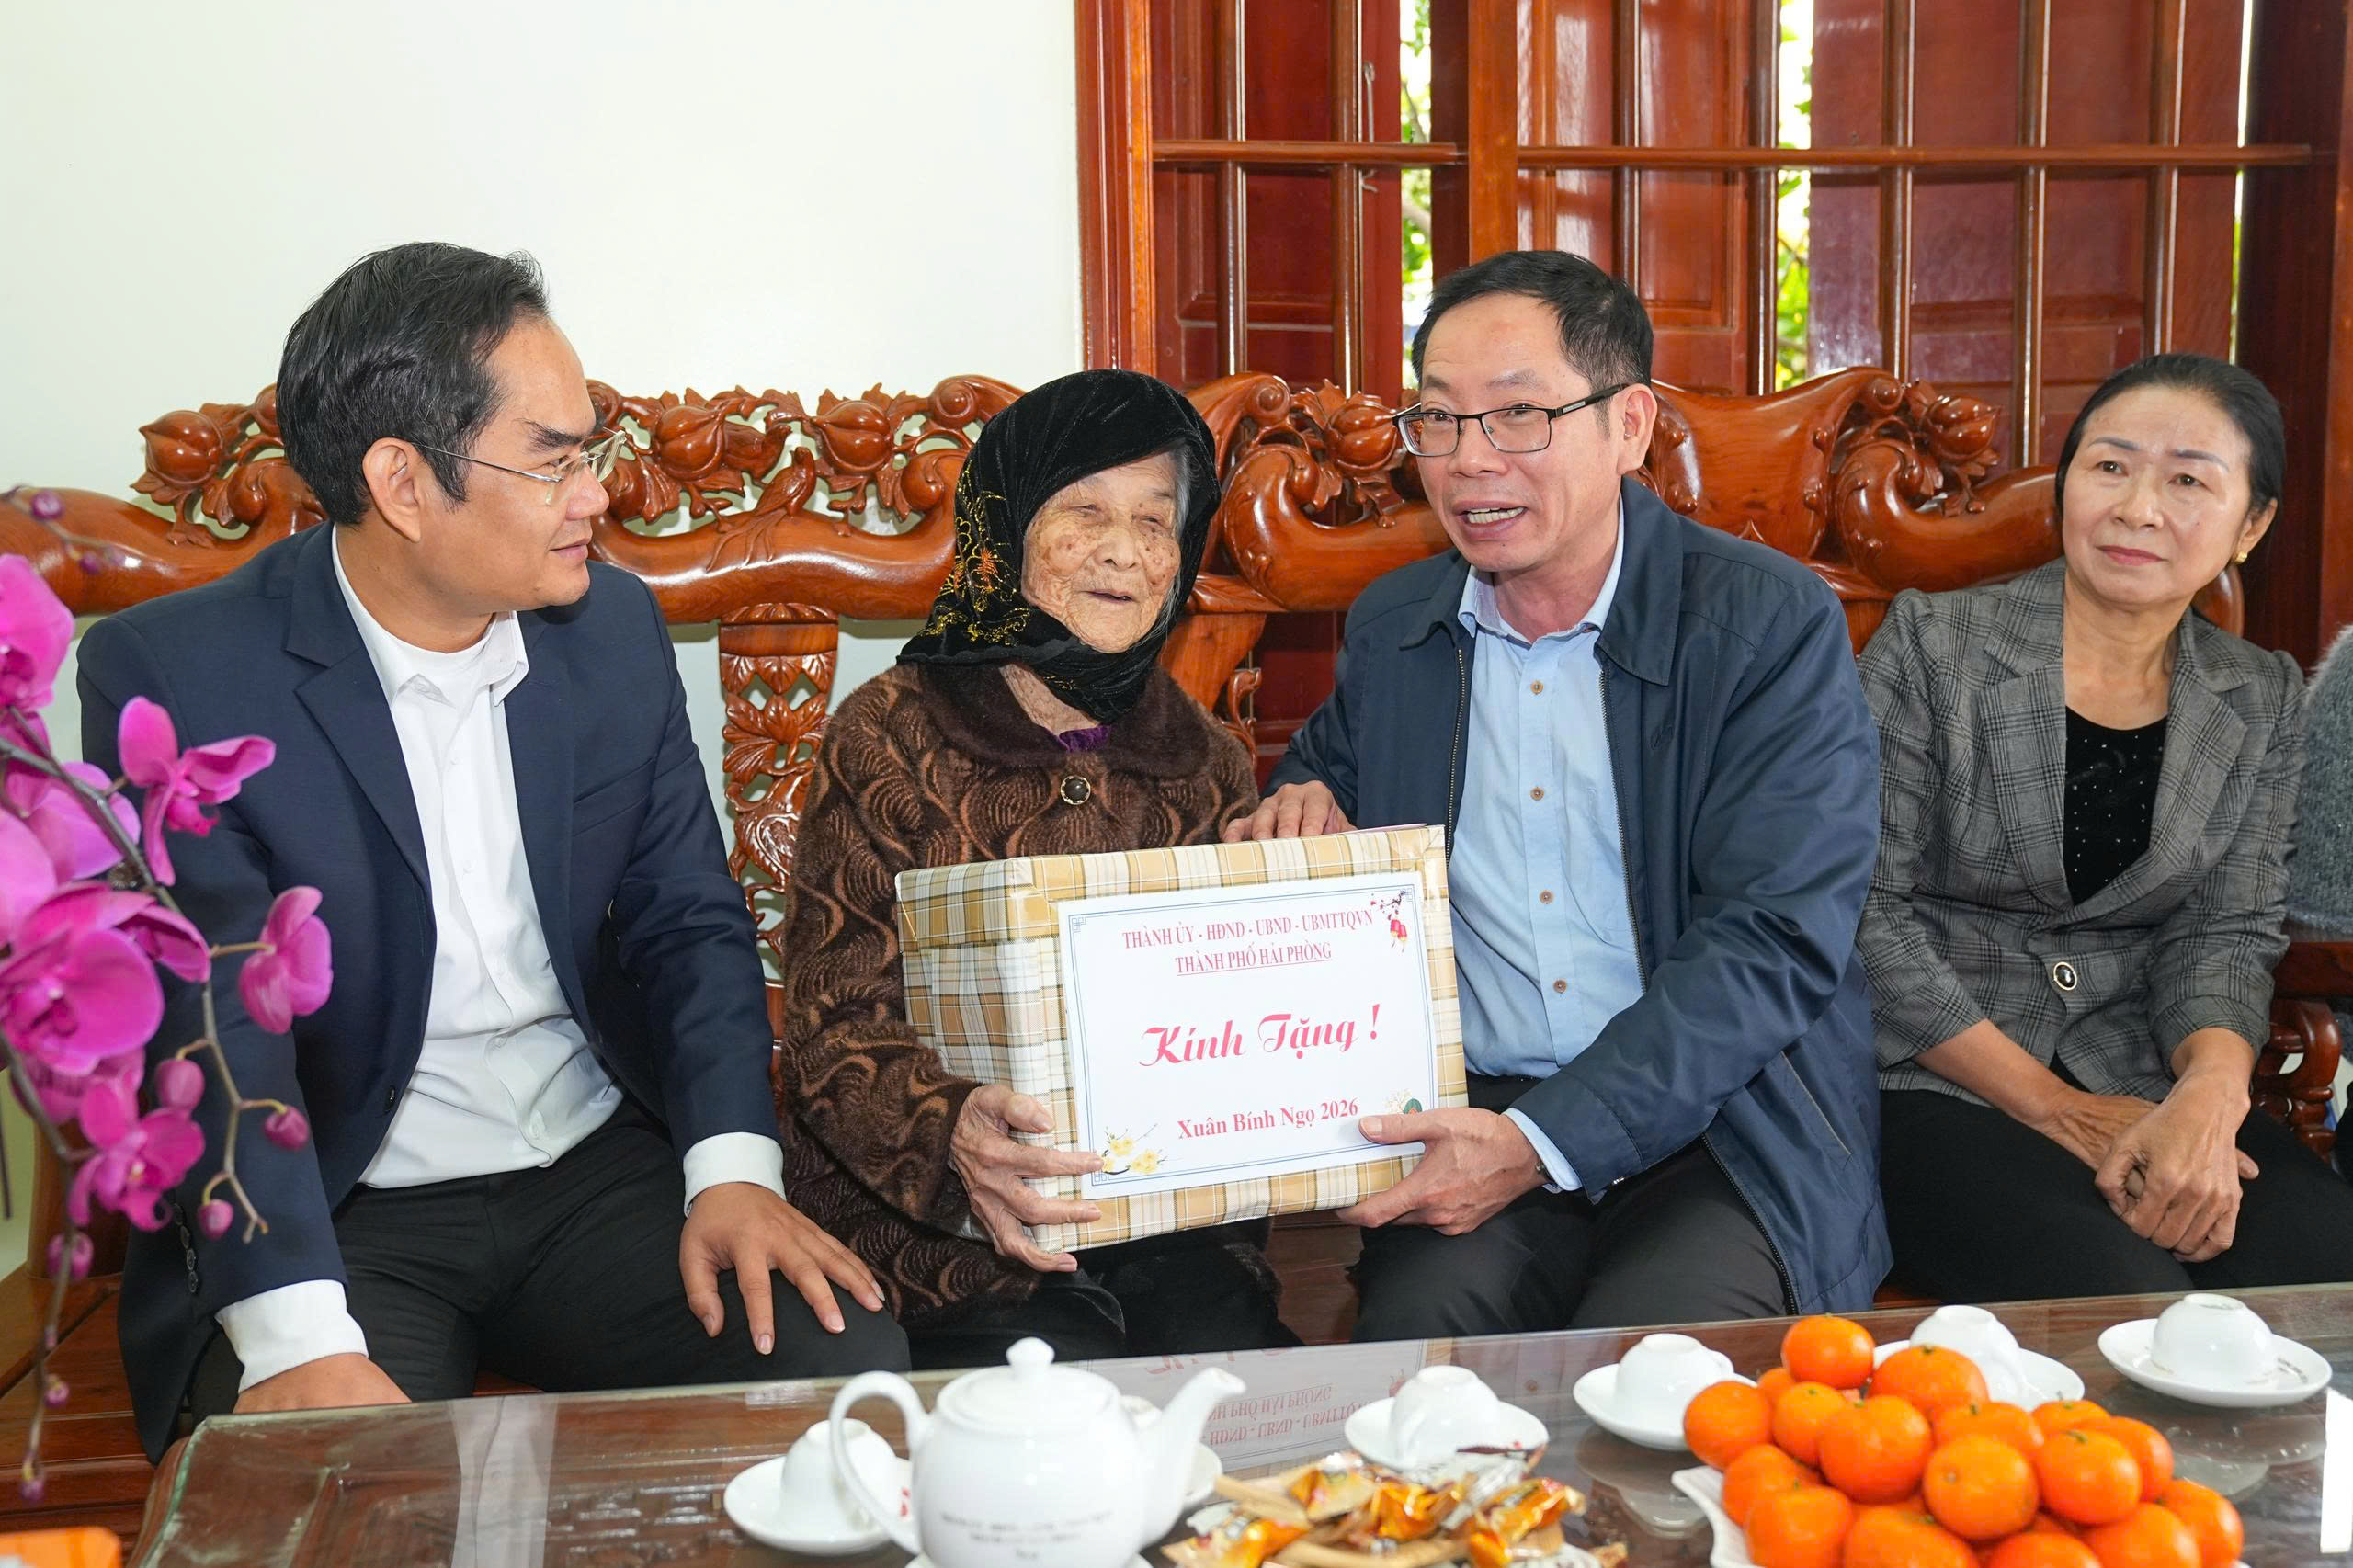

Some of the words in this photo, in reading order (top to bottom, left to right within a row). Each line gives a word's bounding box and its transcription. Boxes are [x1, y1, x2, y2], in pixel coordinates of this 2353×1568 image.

[1122, 925, 1173, 949] THÀNH
[1176, 921, 1194, 944] ỦY
[1206, 921, 1245, 940] HĐND
[1256, 917, 1291, 936] UBND
[1302, 909, 1373, 932] UBMTTQVN
[1175, 950, 1224, 973] THÀNH
[1227, 941, 1256, 969] PHỐ
[1259, 942, 1284, 965] HẢI
[1287, 939, 1332, 962] PHÒNG
[1139, 1019, 1246, 1067] Kính
[1257, 1014, 1359, 1059] Tặng
[1177, 1117, 1227, 1139] Xuân
[1233, 1110, 1276, 1132] Bính
[1280, 1106, 1315, 1128] Ngọ
[1320, 1098, 1358, 1119] 2026
